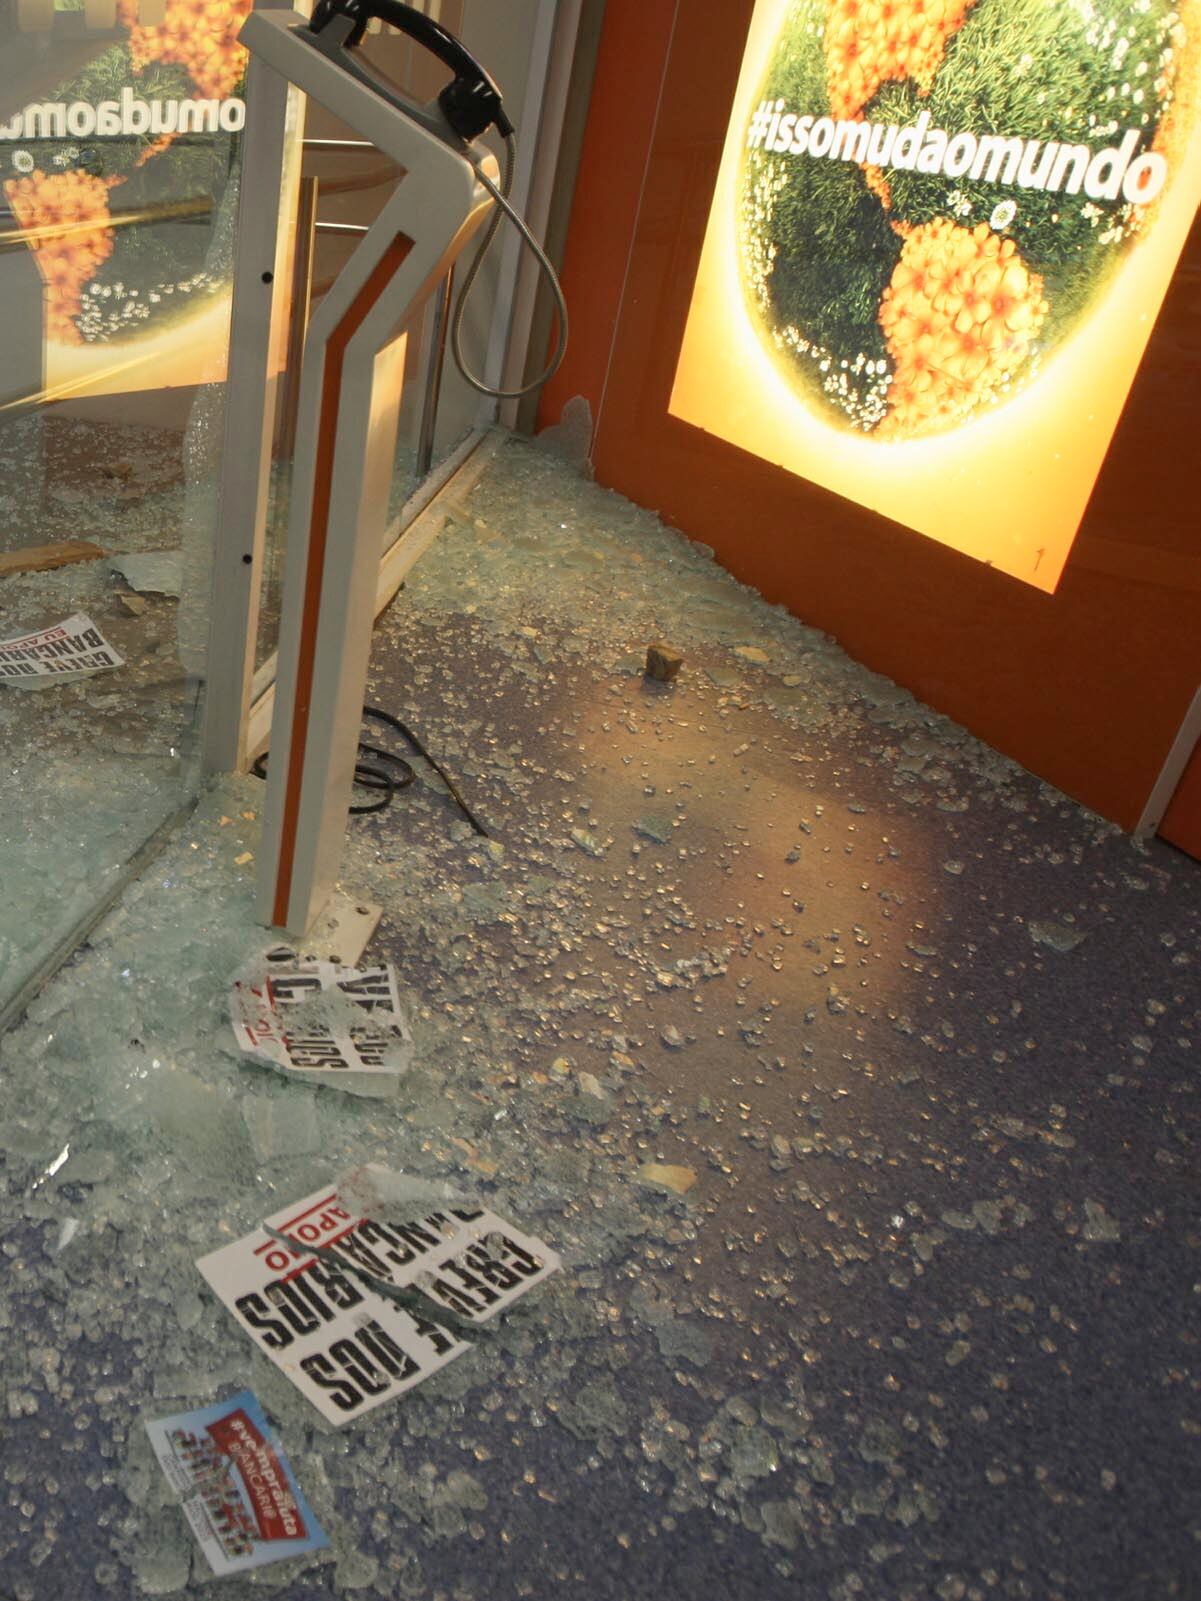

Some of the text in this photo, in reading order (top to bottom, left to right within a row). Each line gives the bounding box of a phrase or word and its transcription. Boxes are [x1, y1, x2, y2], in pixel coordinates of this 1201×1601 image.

[747, 98, 1168, 205] #issomudaomundo
[39, 651, 115, 673] GREVE
[300, 1318, 421, 1411] DOS
